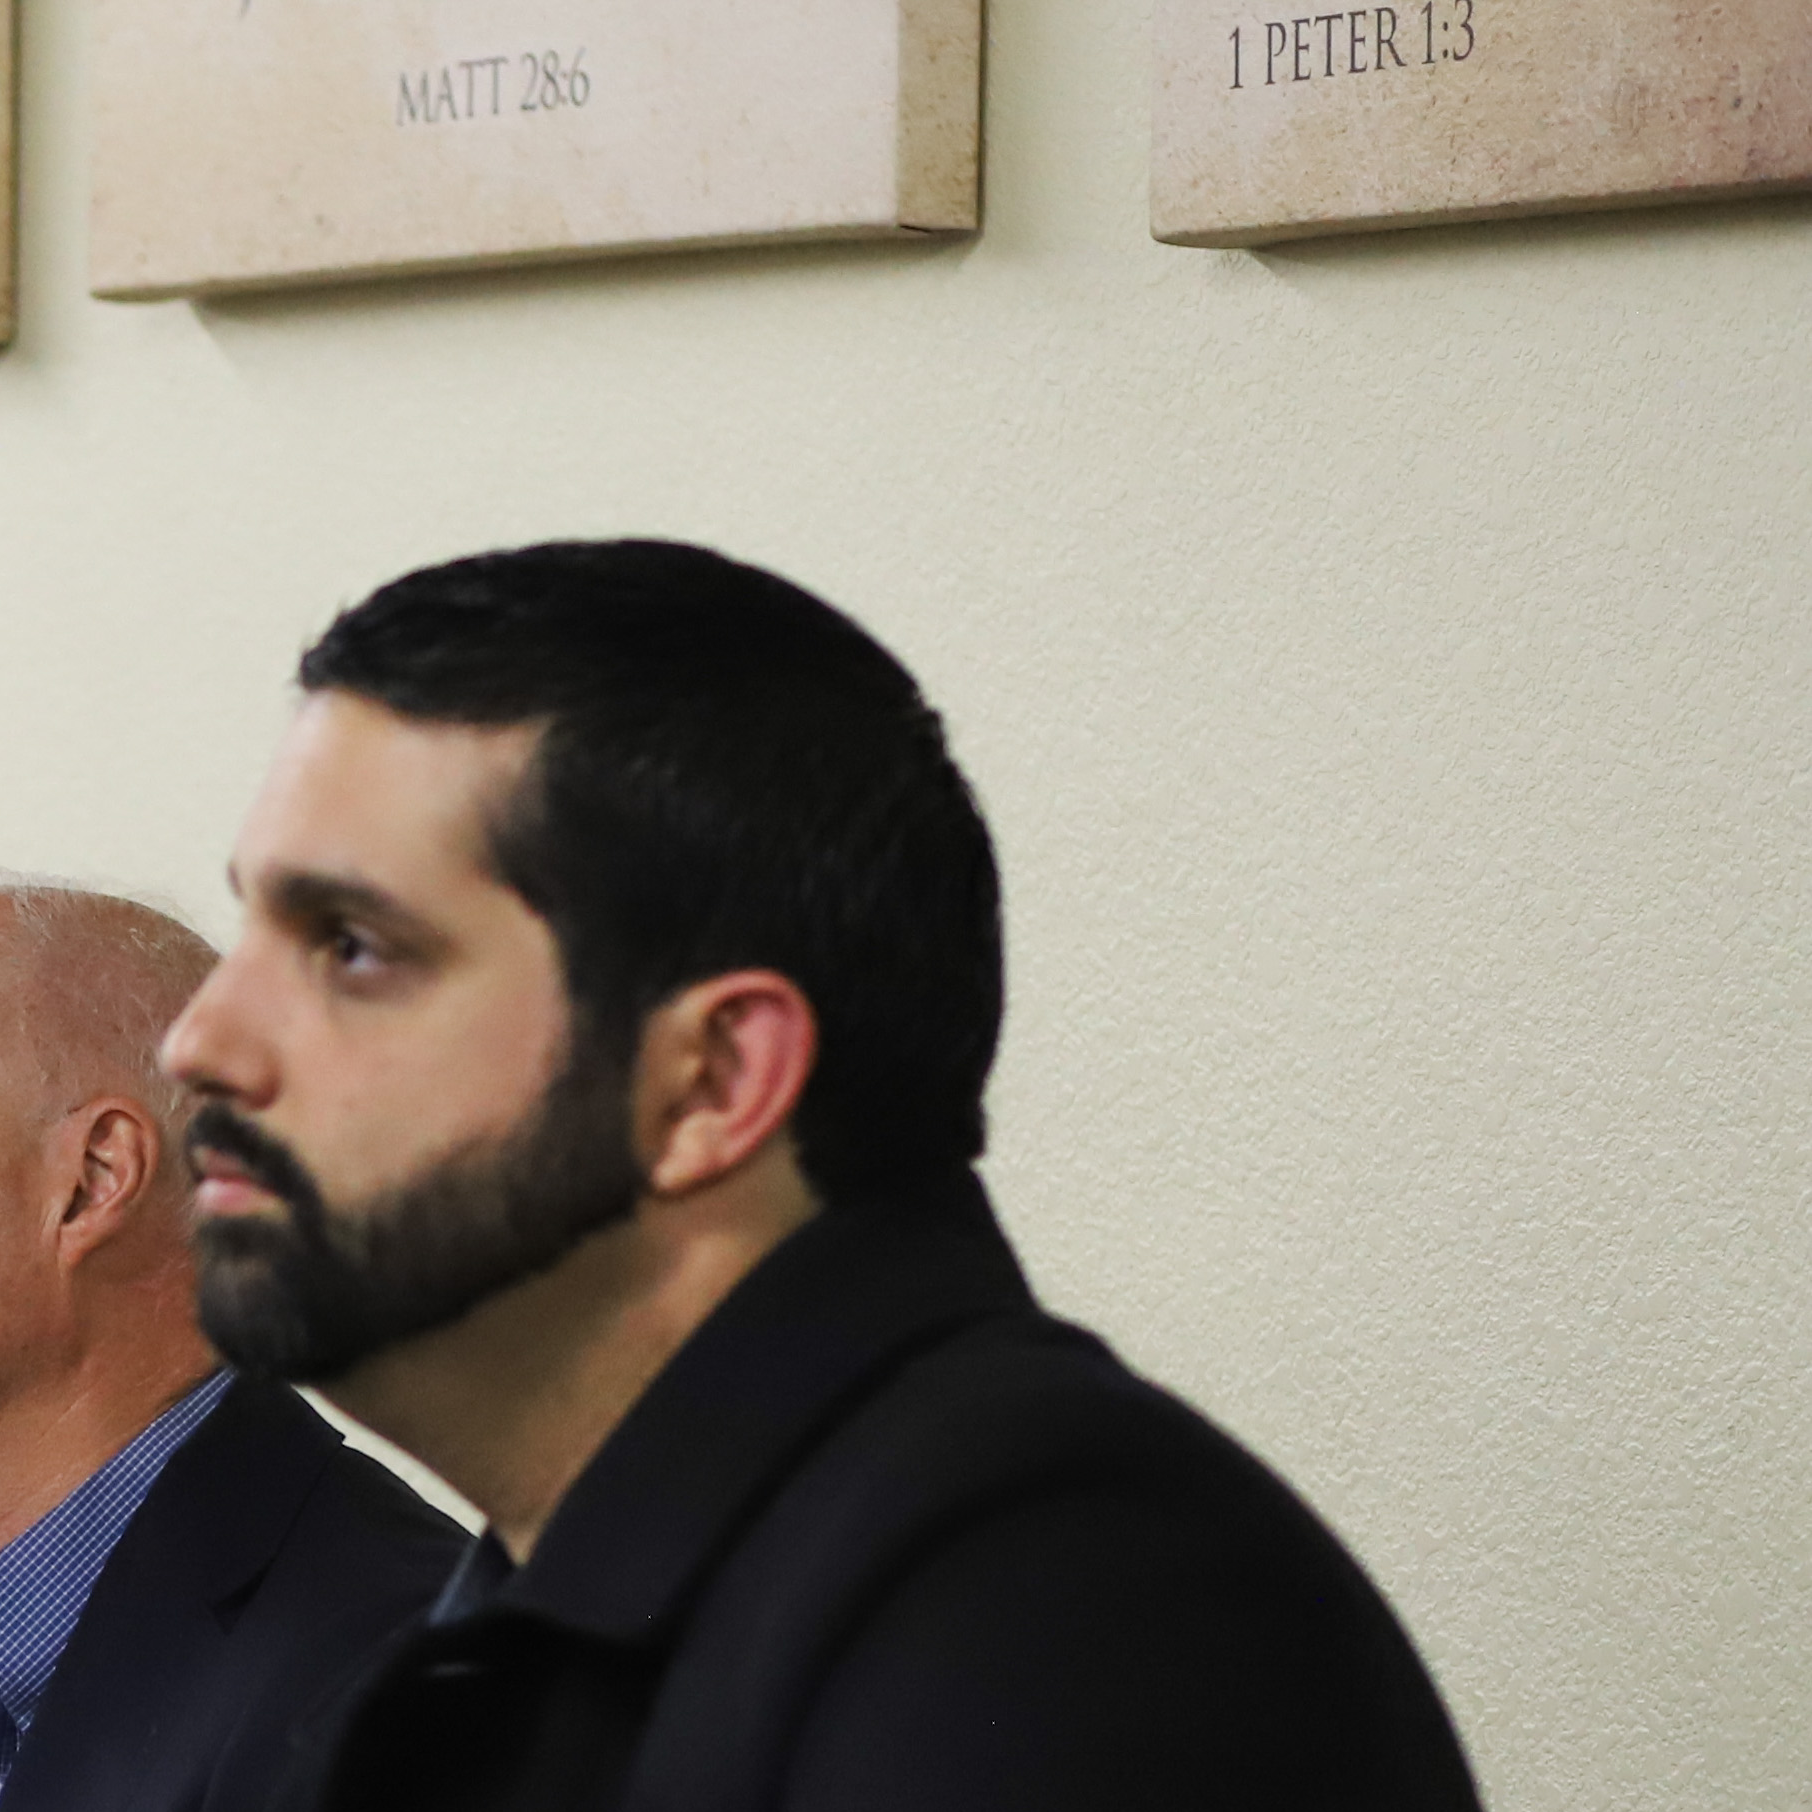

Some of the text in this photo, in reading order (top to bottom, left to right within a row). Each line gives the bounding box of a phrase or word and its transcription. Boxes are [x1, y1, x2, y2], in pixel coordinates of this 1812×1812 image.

[394, 47, 591, 127] MATT 28:6
[1228, 0, 1475, 90] 1 PETER 1:3
